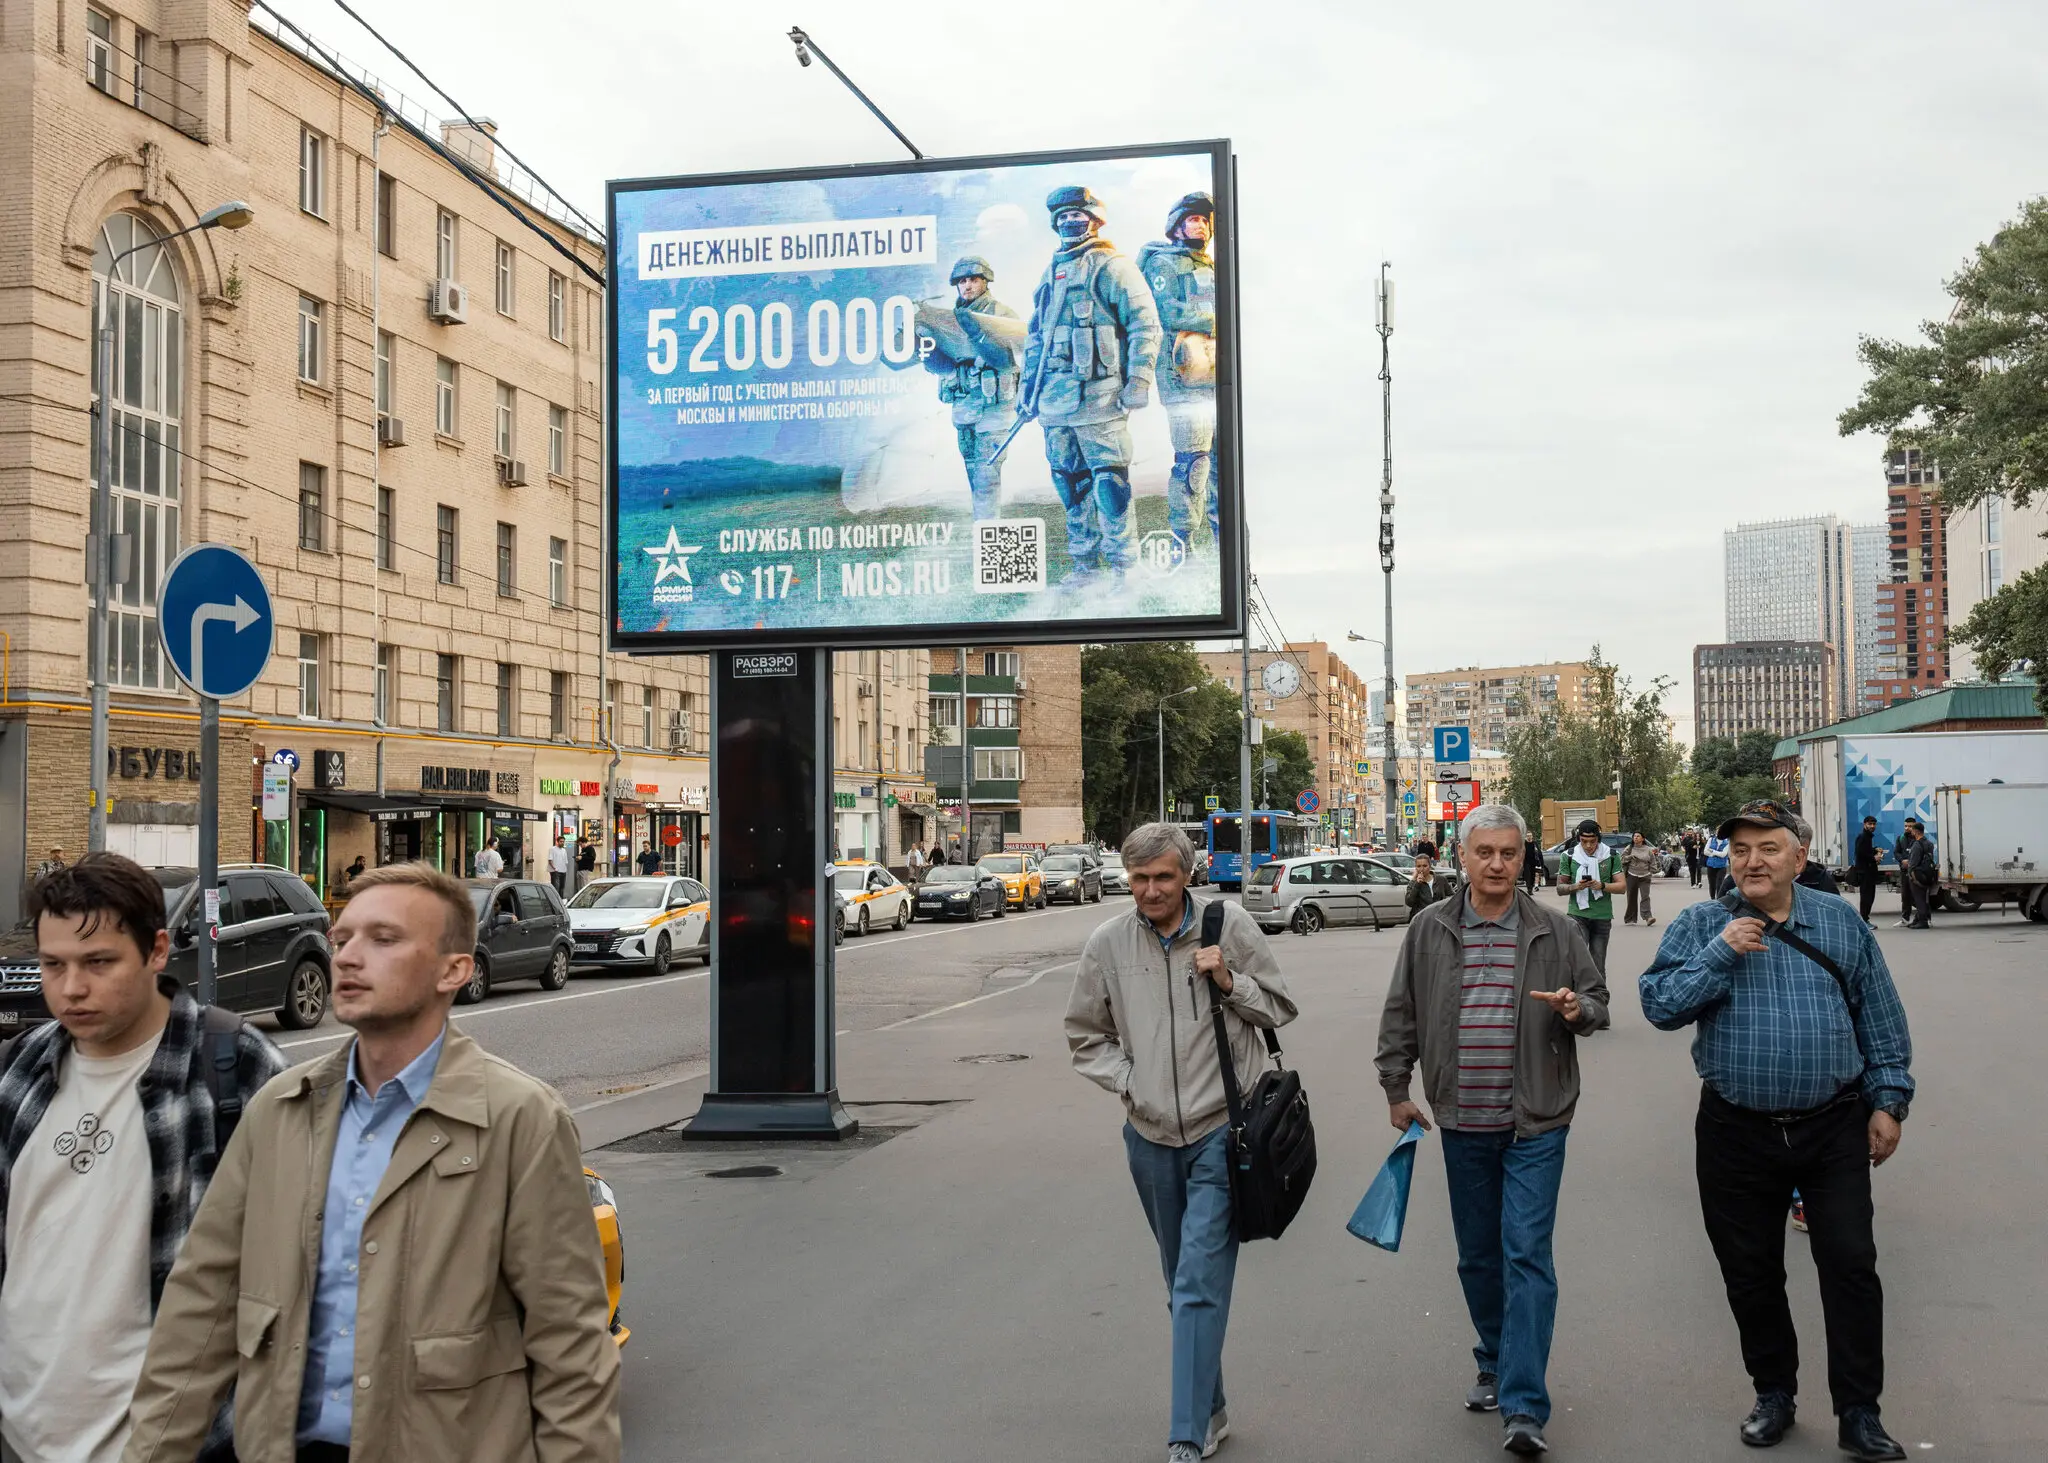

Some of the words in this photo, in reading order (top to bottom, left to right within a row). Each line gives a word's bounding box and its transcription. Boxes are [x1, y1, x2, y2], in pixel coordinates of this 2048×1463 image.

[648, 236, 773, 271] ДЕНЕЖНЫЕ
[781, 229, 892, 260] ВЫПЛАТЫ
[901, 227, 926, 253] ОТ
[647, 308, 678, 374] 5
[688, 302, 793, 372] 200
[648, 388, 662, 404] ЗА
[665, 383, 709, 404] ПЕРВЫЙ
[713, 385, 733, 403] ГОД
[736, 384, 743, 400] С
[745, 382, 789, 400] УЧЕТОМ
[791, 380, 836, 398] ВЫПЛАТ
[677, 408, 725, 425] МОСКВЫ
[728, 406, 736, 422] И
[739, 402, 824, 423] МИНИСТЕРСТВА
[827, 399, 880, 419] ОБОРОНЫ
[719, 526, 803, 553] СЛУЖБА
[808, 526, 834, 550] ПО
[839, 521, 953, 548] КОНТРАКТУ
[1145, 538, 1182, 569] 18+
[653, 585, 693, 594] АРМИЯ
[752, 564, 793, 599] 117
[841, 559, 951, 597] MOS.RU
[653, 594, 693, 603] РОССИИ
[735, 656, 794, 668] РАСВЭРО
